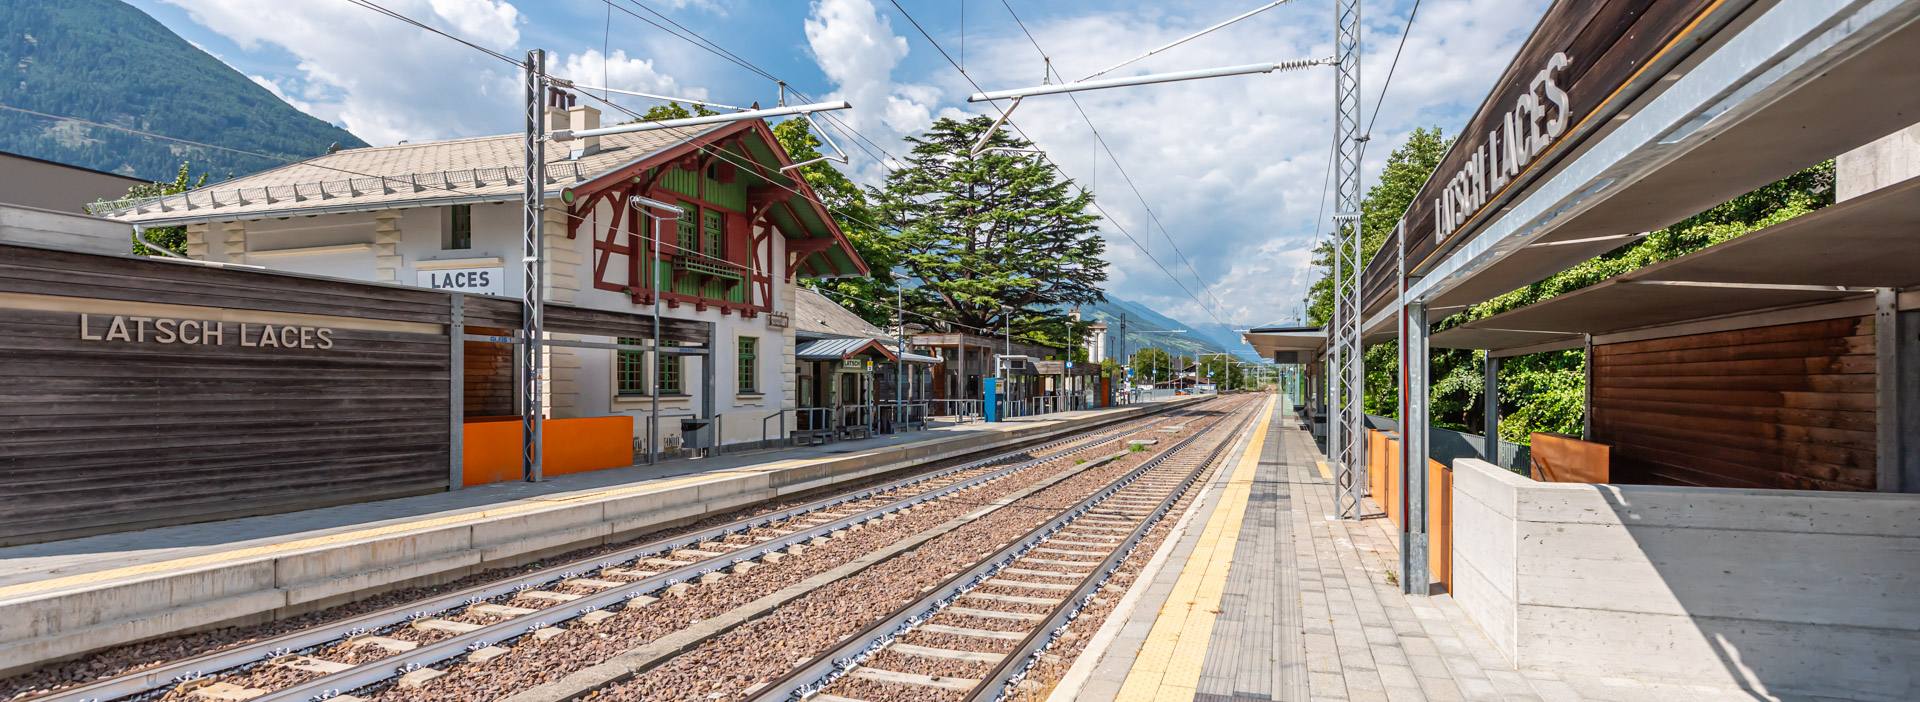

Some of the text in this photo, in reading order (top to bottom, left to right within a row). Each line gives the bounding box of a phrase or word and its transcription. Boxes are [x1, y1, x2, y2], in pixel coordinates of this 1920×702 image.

[1435, 52, 1569, 245] LATSCH LACES
[431, 271, 490, 289] LACES
[81, 313, 333, 349] LATSCH LACES
